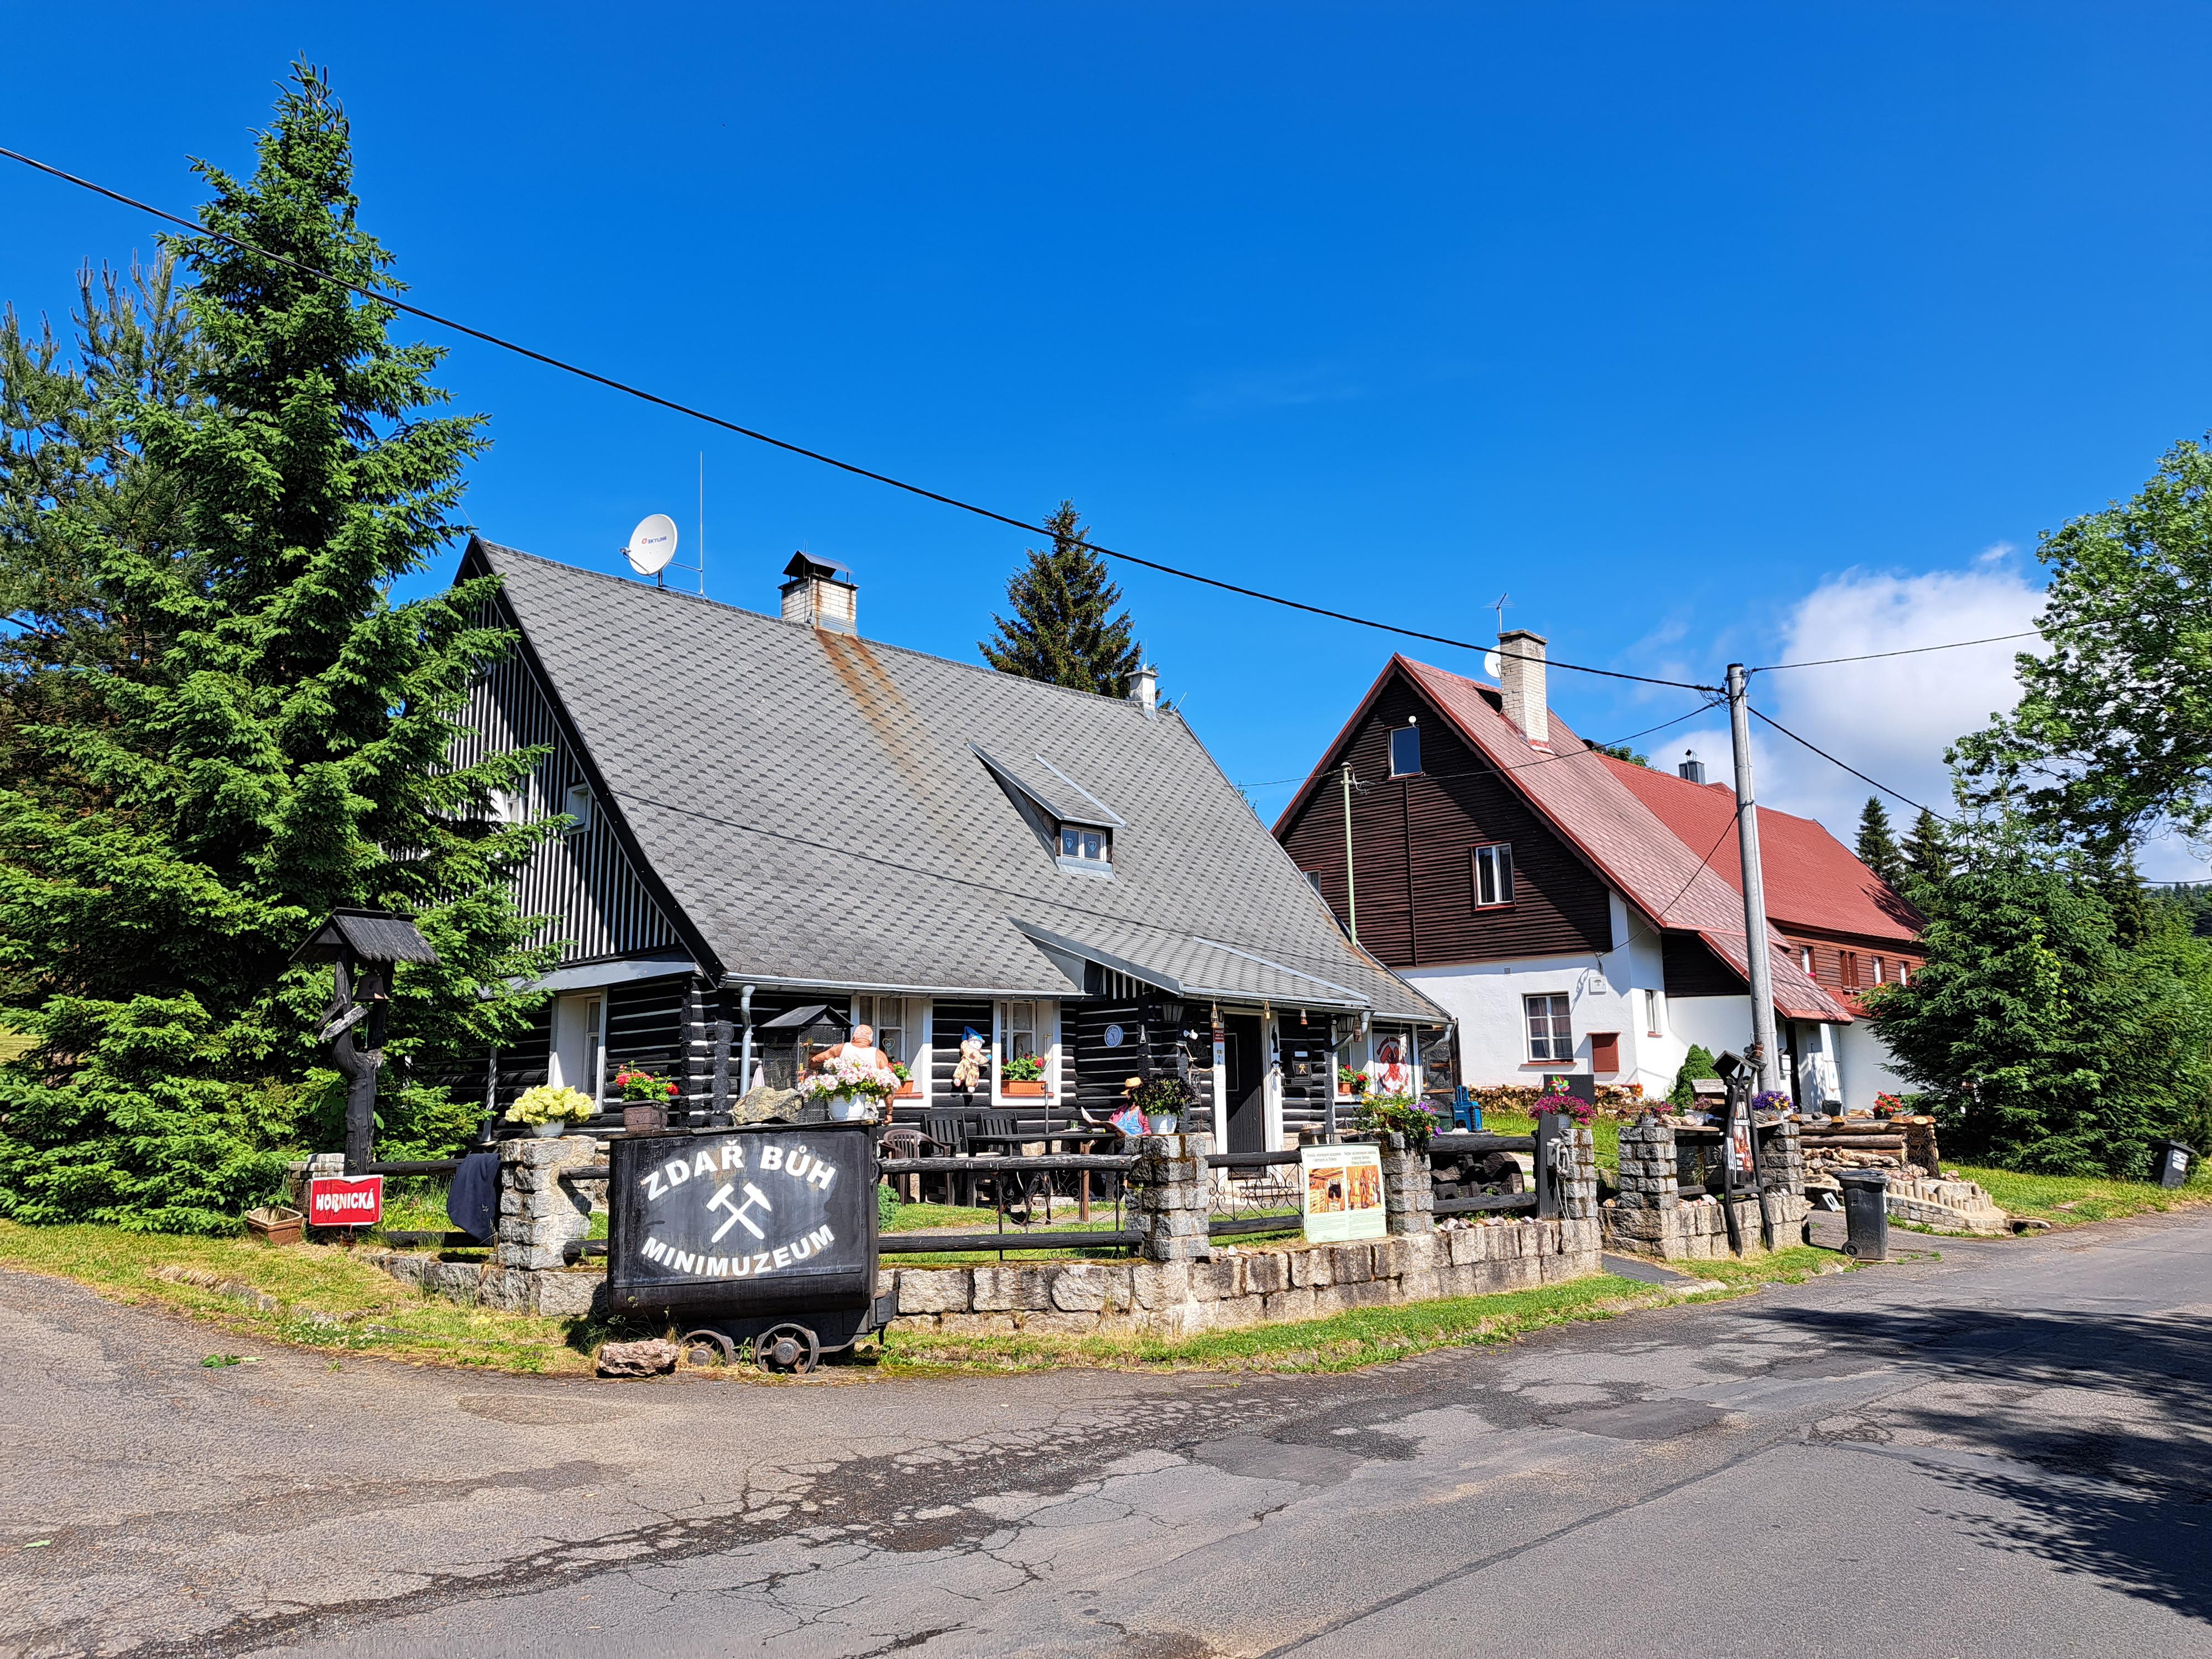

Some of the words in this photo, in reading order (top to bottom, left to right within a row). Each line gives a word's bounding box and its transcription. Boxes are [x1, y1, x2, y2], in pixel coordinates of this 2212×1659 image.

[642, 1140, 744, 1201] ZDAŘ
[760, 1145, 836, 1190] BŮH
[316, 1188, 375, 1213] HORNICKÁ
[641, 1224, 835, 1277] MINIMUZEUM
